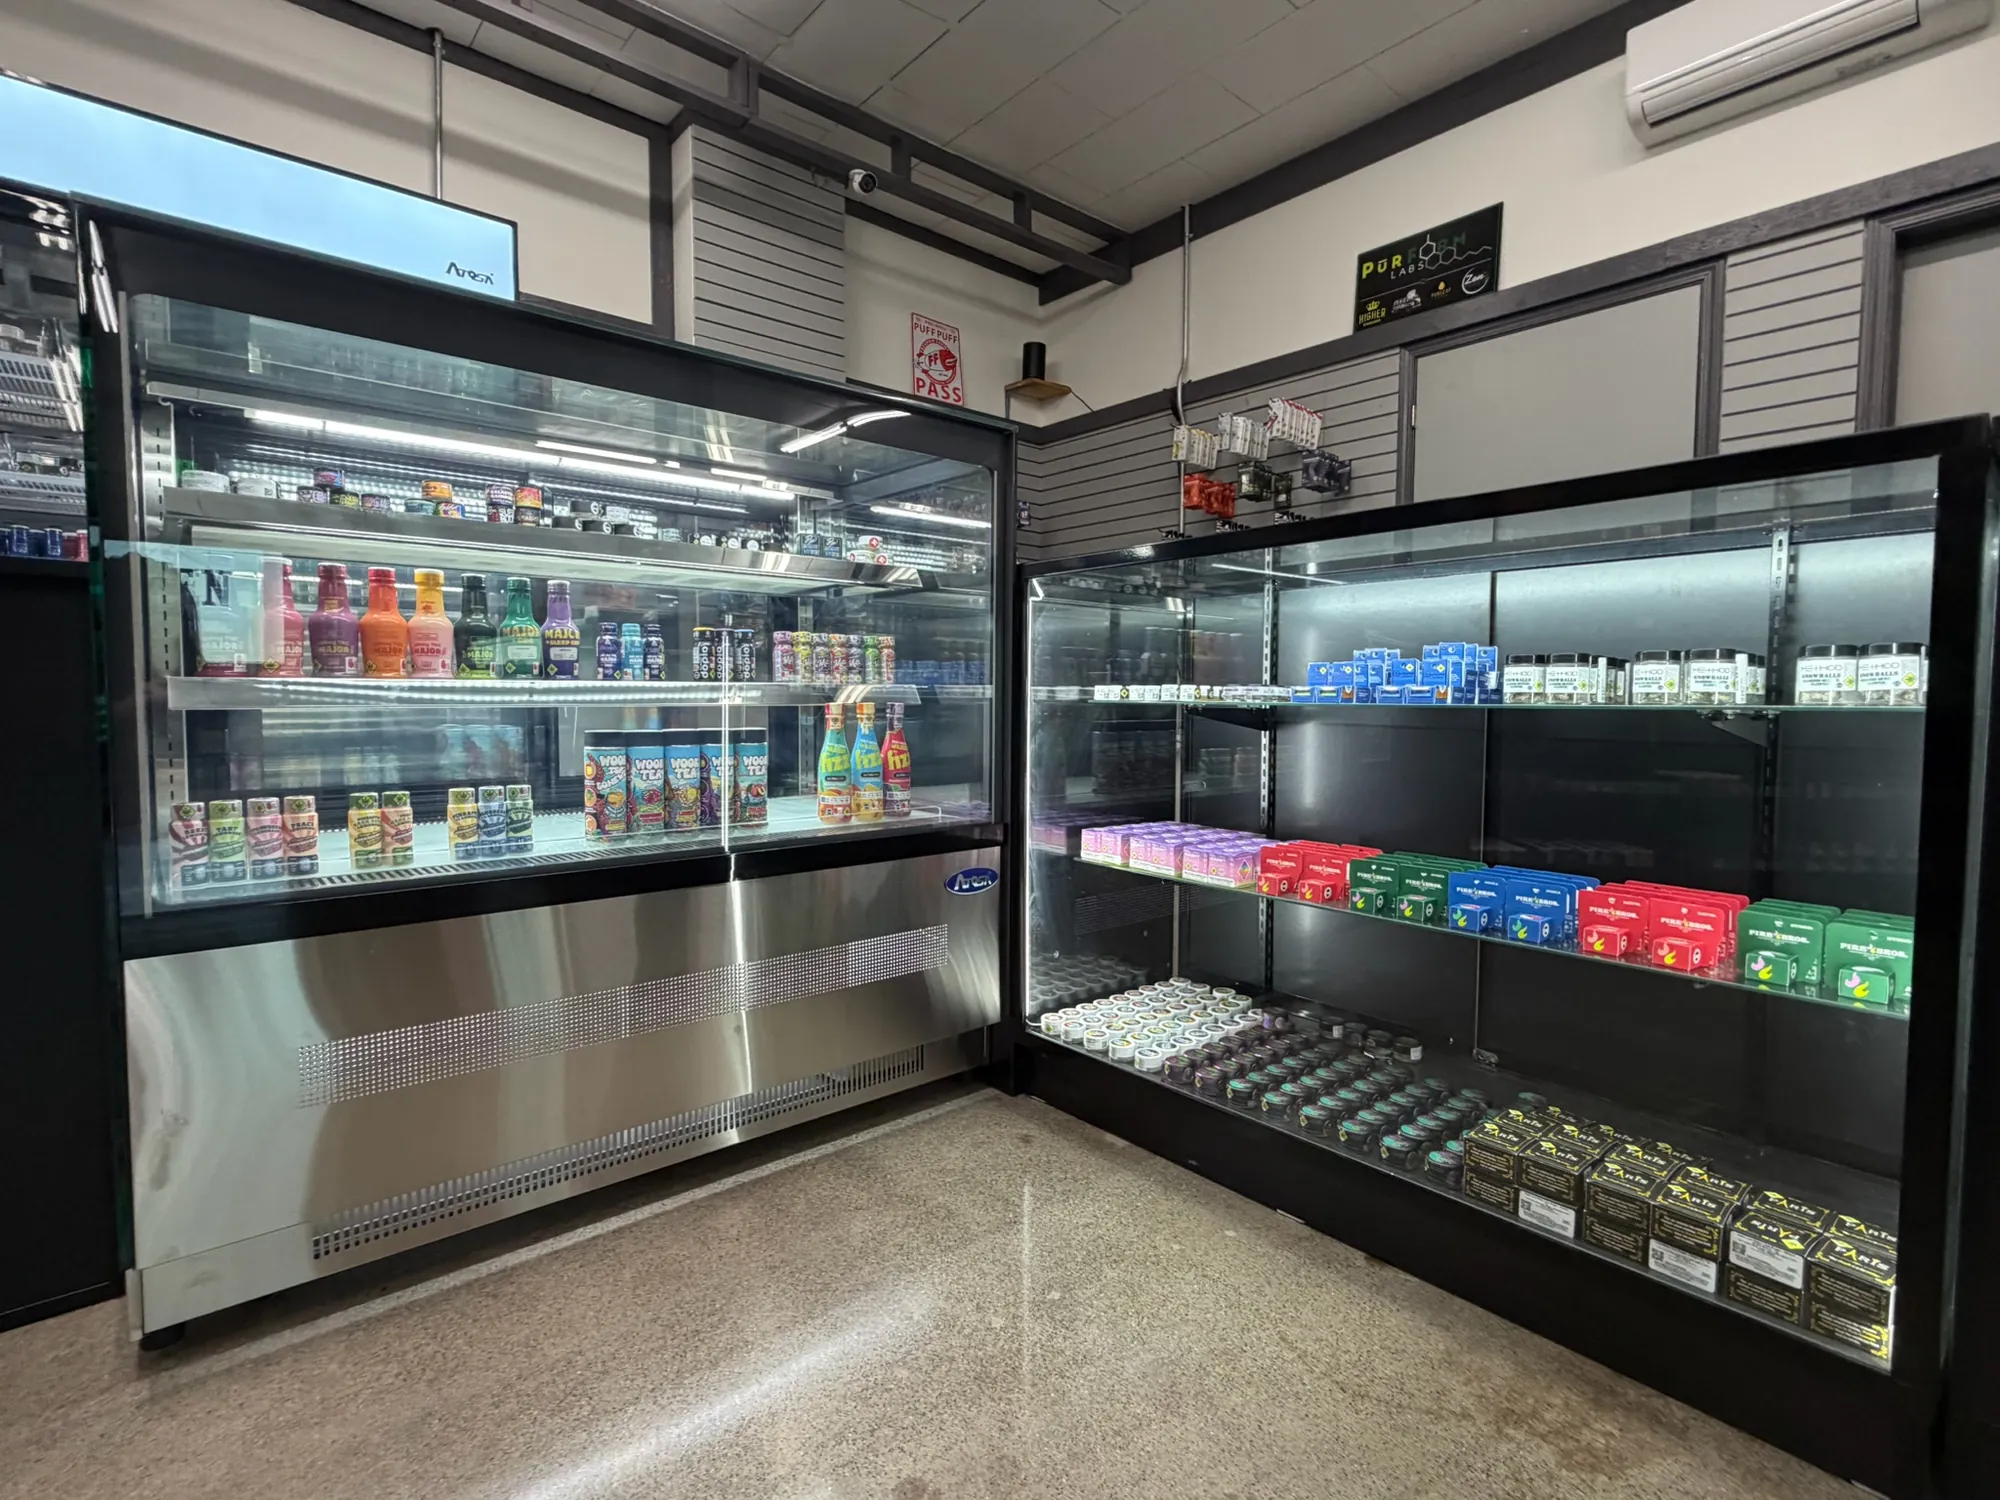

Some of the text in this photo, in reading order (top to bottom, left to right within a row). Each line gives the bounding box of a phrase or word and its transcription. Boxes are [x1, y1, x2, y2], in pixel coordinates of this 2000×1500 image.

[1391, 261, 1424, 280] LABS
[1358, 308, 1386, 325] HIGHER
[914, 322, 936, 334] PUFF
[937, 330, 958, 343] PUFF
[916, 377, 962, 403] PASS
[641, 770, 662, 780] TEA
[675, 768, 697, 779] TEA
[748, 765, 767, 776] TEA
